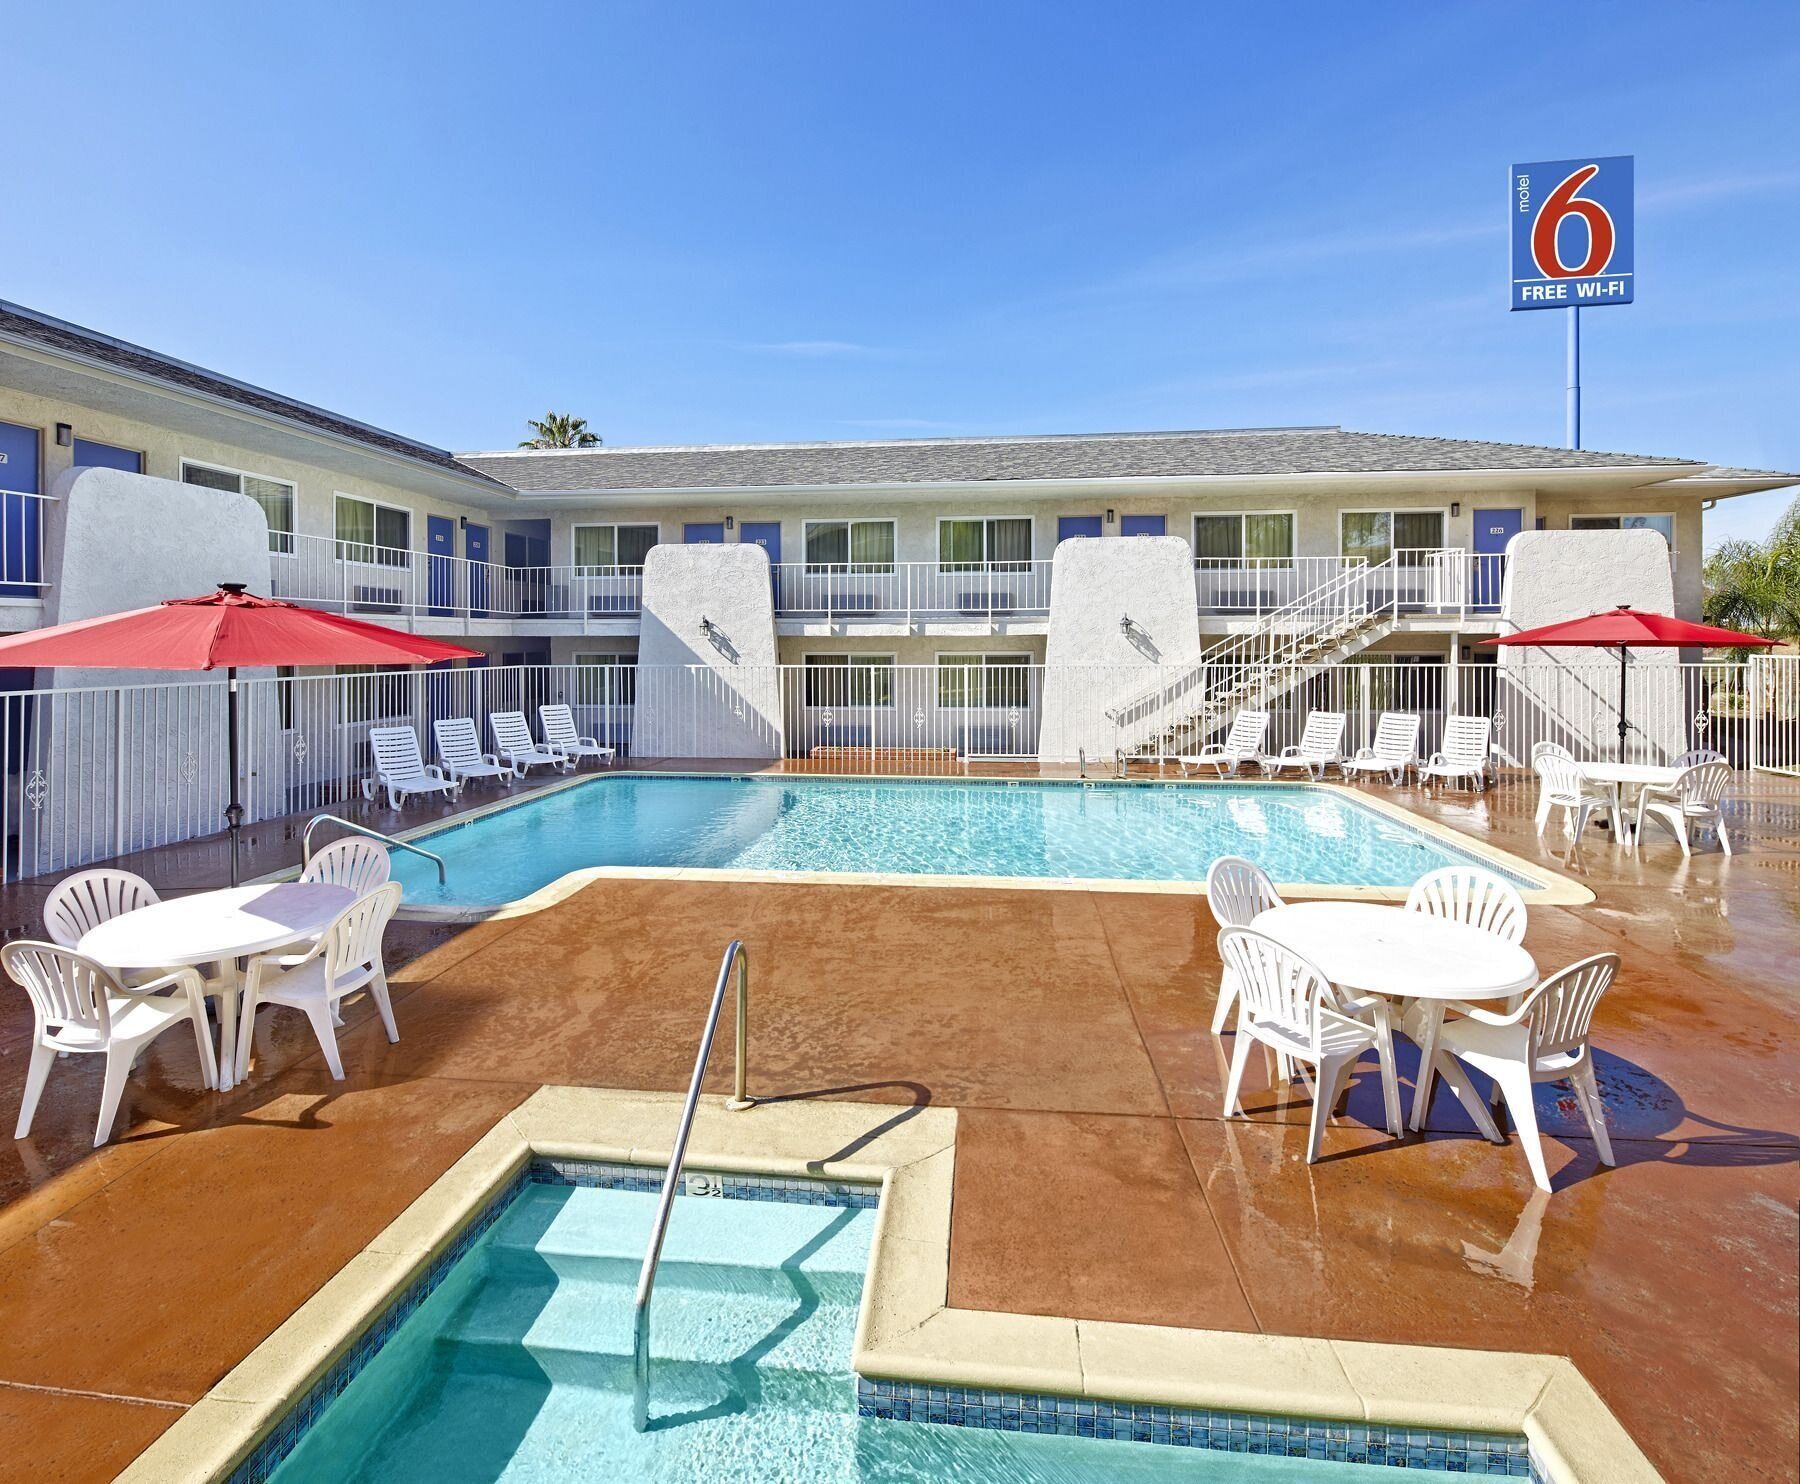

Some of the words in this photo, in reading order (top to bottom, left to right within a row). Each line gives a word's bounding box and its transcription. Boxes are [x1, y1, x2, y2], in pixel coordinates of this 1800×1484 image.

[1517, 174, 1529, 212] motel
[1531, 164, 1615, 279] 6
[1522, 285, 1567, 301] FREE
[1576, 281, 1624, 298] WI-FI
